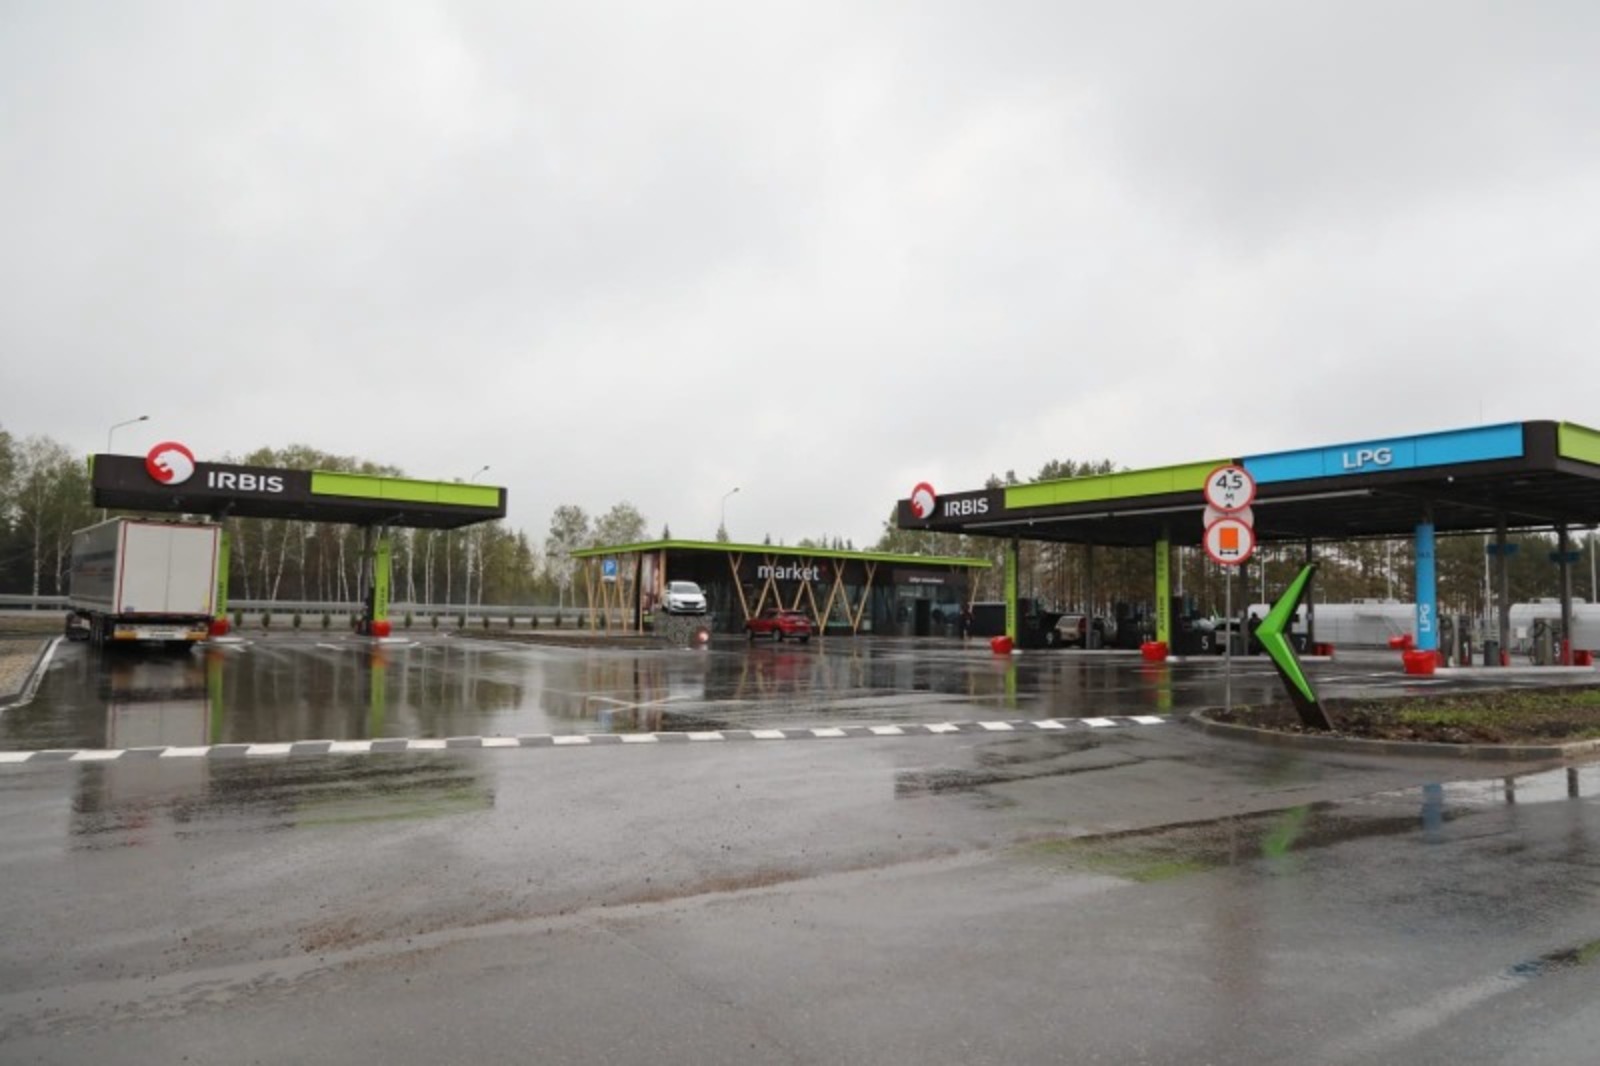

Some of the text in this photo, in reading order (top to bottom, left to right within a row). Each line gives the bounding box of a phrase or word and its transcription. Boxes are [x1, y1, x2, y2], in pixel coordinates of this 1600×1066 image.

[1342, 447, 1392, 470] LPG
[207, 471, 284, 494] IRBIS
[944, 497, 989, 518] IRBIS
[757, 562, 820, 582] market
[1420, 603, 1430, 633] LPG
[1201, 635, 1209, 650] 5
